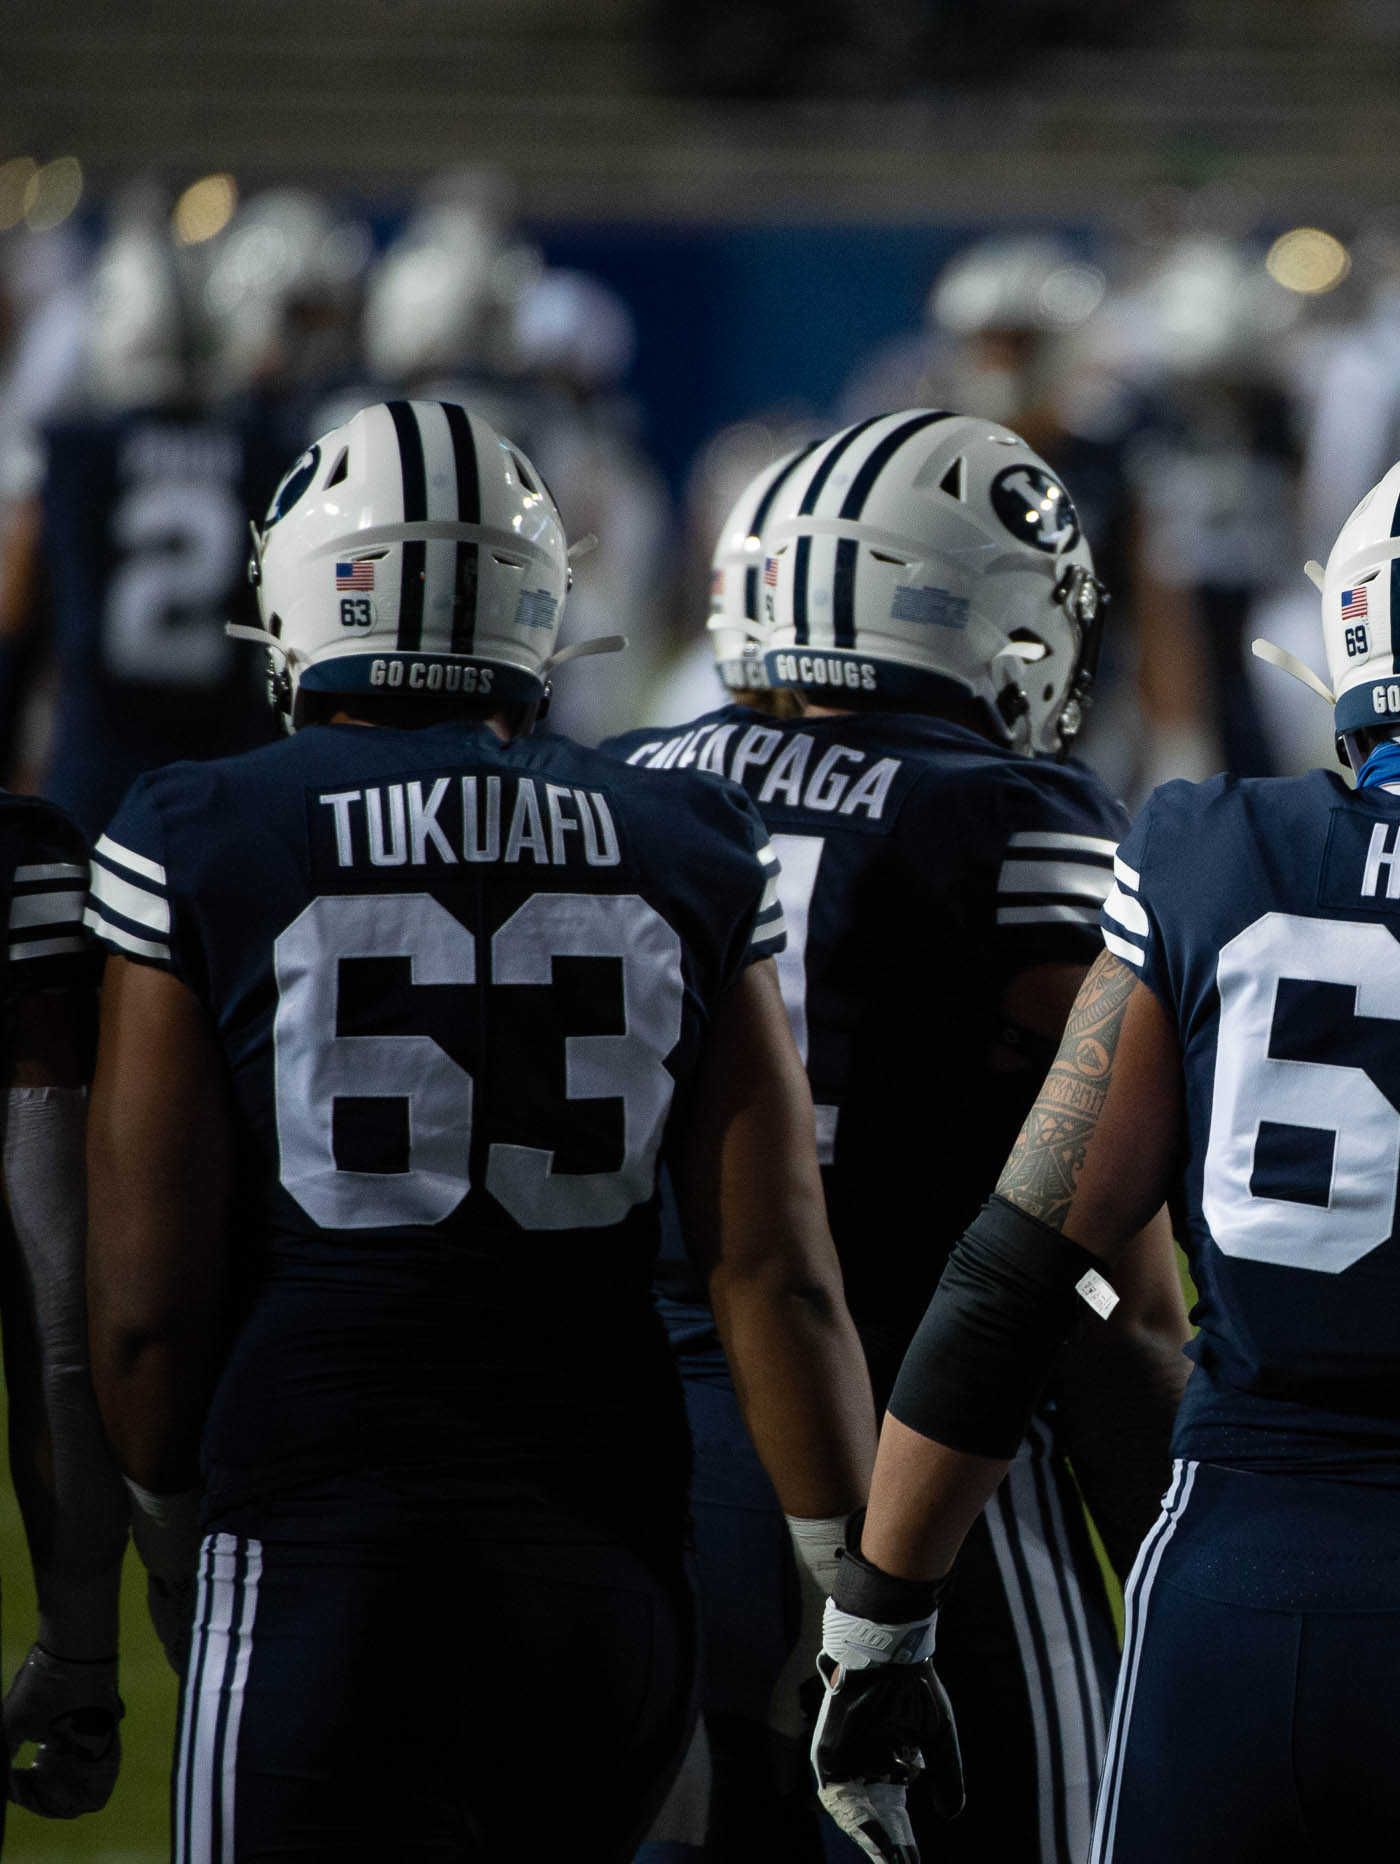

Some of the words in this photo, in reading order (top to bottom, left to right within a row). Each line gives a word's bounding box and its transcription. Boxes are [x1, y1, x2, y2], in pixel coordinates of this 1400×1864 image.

[340, 599, 371, 627] 63
[1345, 624, 1368, 657] 69
[370, 659, 404, 687] GO
[408, 662, 495, 694] COUGS
[776, 654, 798, 681] GO
[799, 656, 877, 691] COUGS
[319, 776, 622, 867] TUKUAFU
[274, 892, 685, 1231] 63
